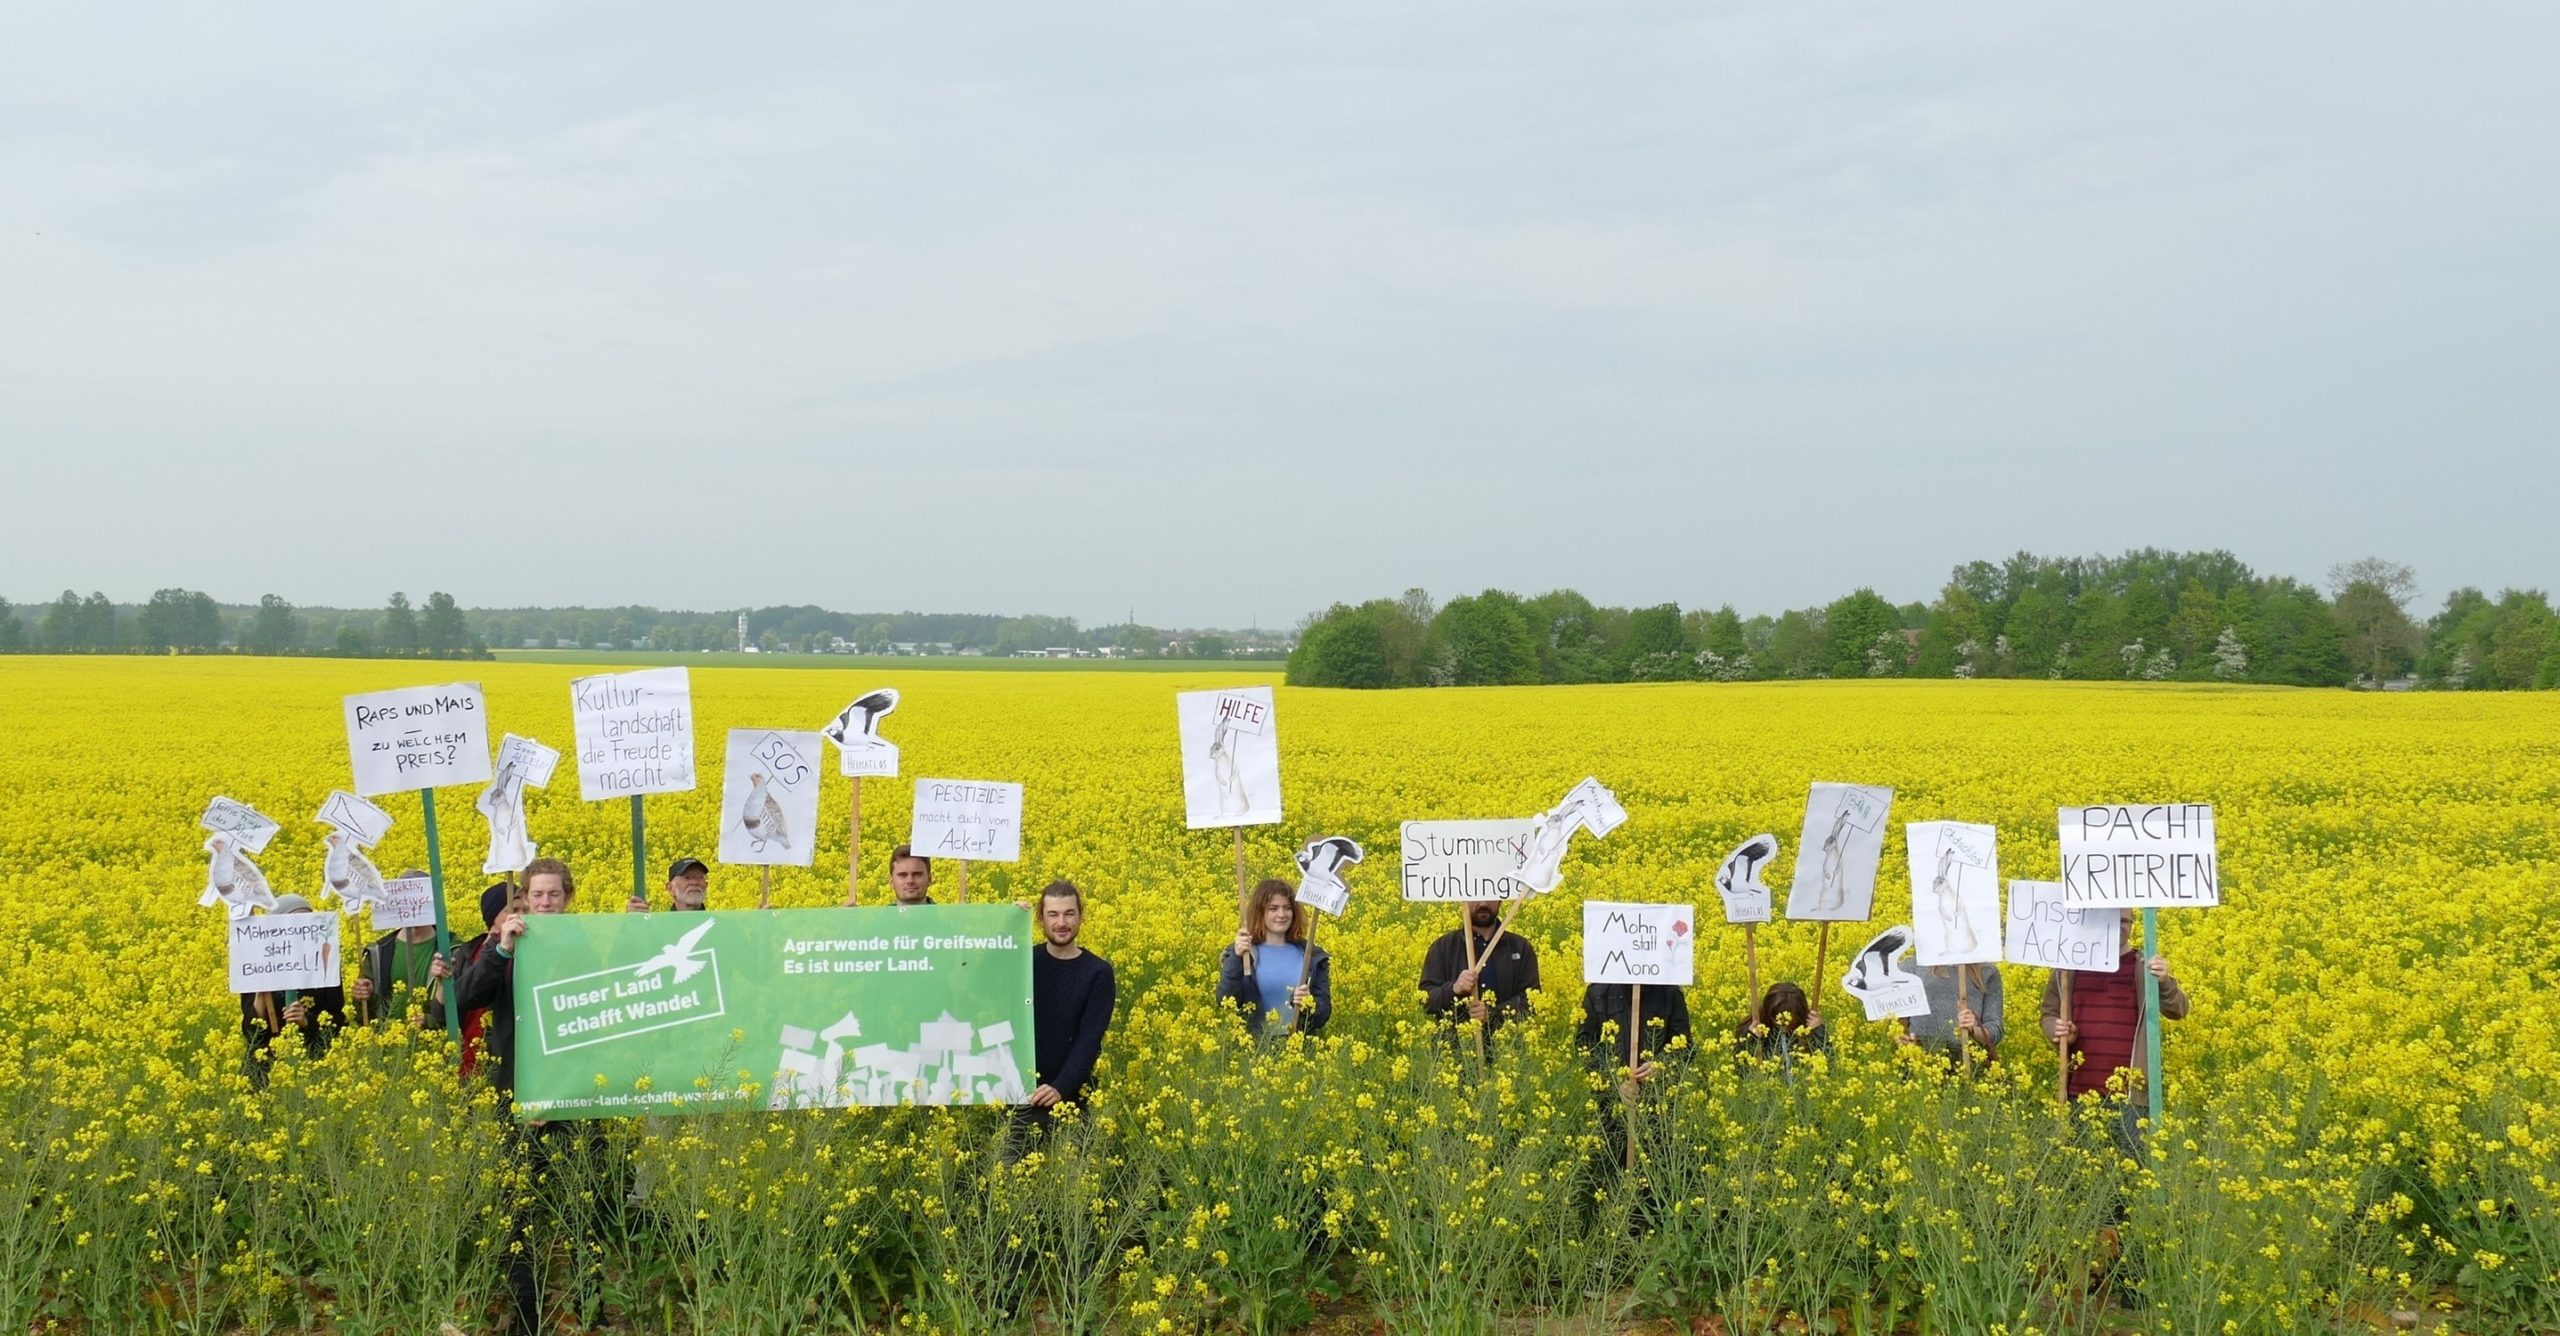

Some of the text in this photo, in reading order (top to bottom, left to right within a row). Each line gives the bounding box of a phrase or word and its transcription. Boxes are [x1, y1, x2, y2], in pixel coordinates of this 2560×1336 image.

[575, 679, 654, 712] Kultur-
[356, 695, 474, 730] RAPS UND MAIS
[601, 707, 684, 738] landschaft
[1219, 697, 1263, 725] HILFE
[395, 745, 457, 773] PREIS?
[582, 736, 673, 765] die Freude
[762, 740, 809, 786] SOS
[600, 761, 667, 791] macht
[931, 783, 1007, 804] PESTIZIDE
[919, 810, 953, 824] macht
[989, 818, 1010, 828] vom
[2081, 804, 2210, 842] PACHT
[938, 828, 997, 854] Acker!
[1405, 822, 1515, 862] Stummer
[2062, 852, 2214, 901] KRITERIEN
[1602, 911, 1658, 935] Mohn
[783, 935, 1018, 954] Agrarwende für Greifswald.
[2022, 921, 2111, 967] Acker!
[784, 957, 934, 974] Es ist unser Land.
[1600, 950, 1660, 976] Mono
[552, 973, 663, 1012] Unser Land
[556, 990, 701, 1038] schafft Wandel
